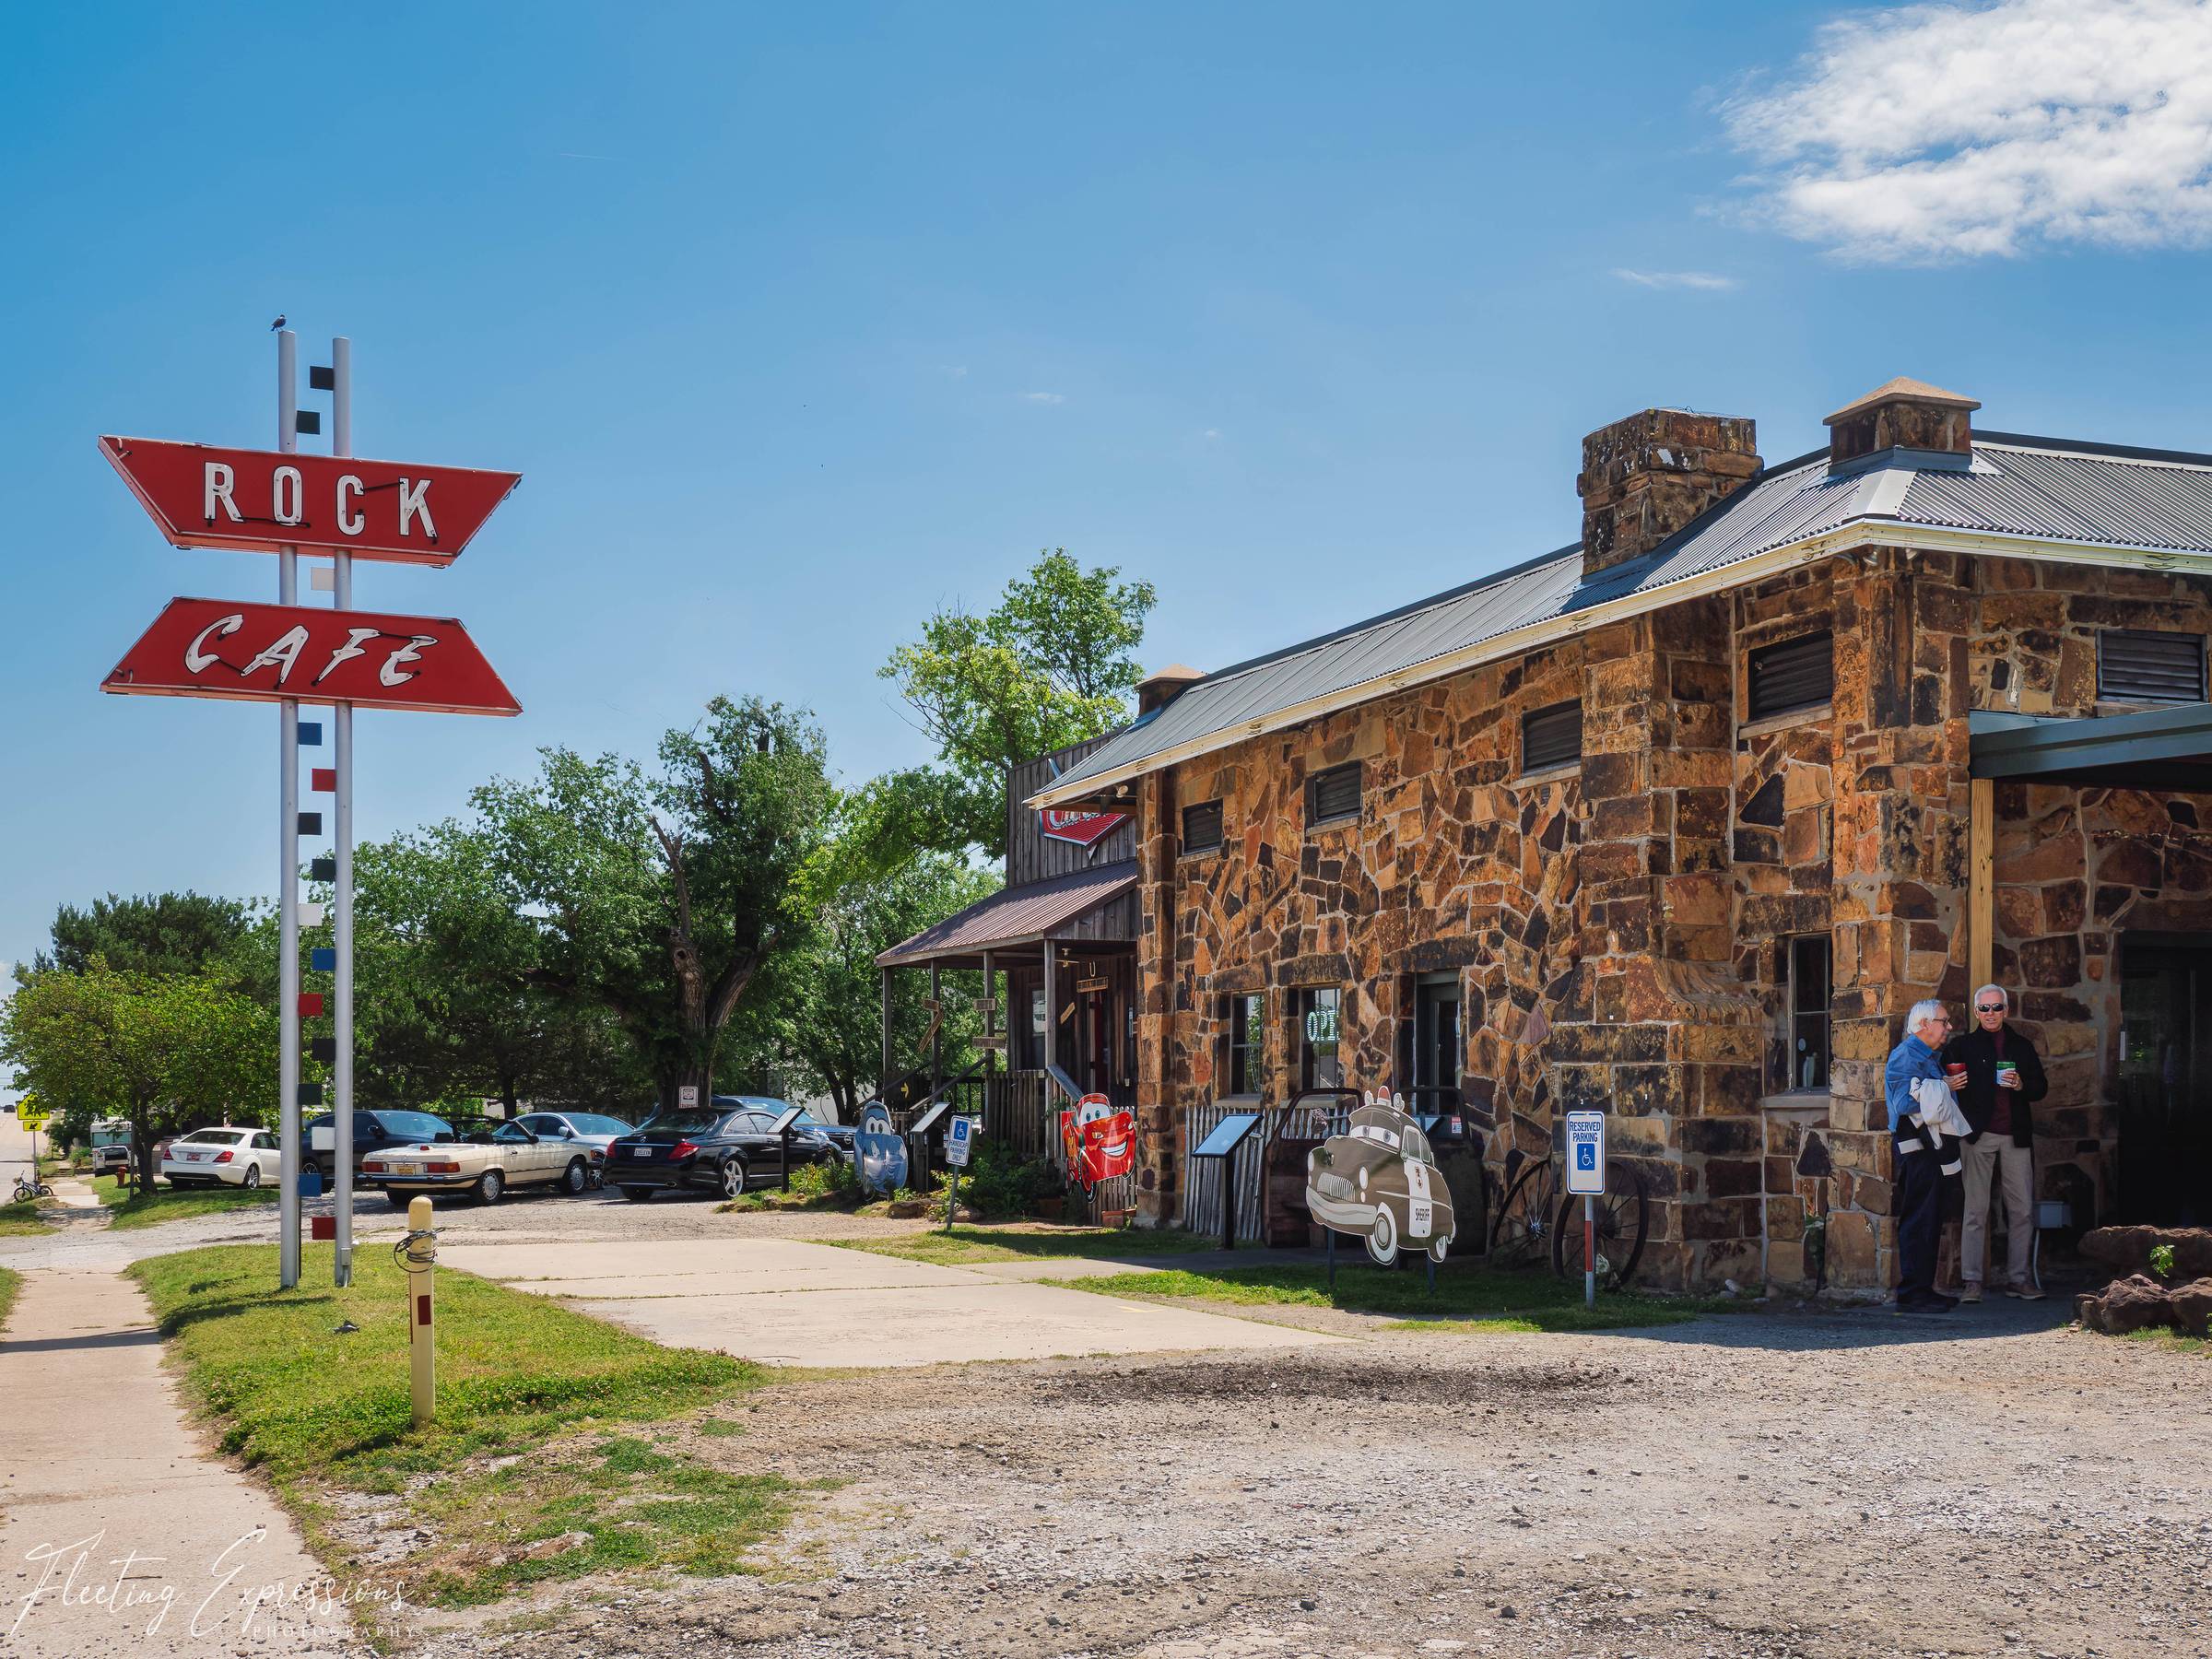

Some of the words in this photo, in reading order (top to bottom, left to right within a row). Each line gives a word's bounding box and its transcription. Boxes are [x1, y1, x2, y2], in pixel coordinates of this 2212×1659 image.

[204, 461, 438, 538] ROCK
[185, 614, 439, 687] CAFE
[1569, 1121, 1601, 1132] RESERVED
[1572, 1132, 1598, 1143] PARKING
[1415, 1207, 1430, 1221] SHERIFF
